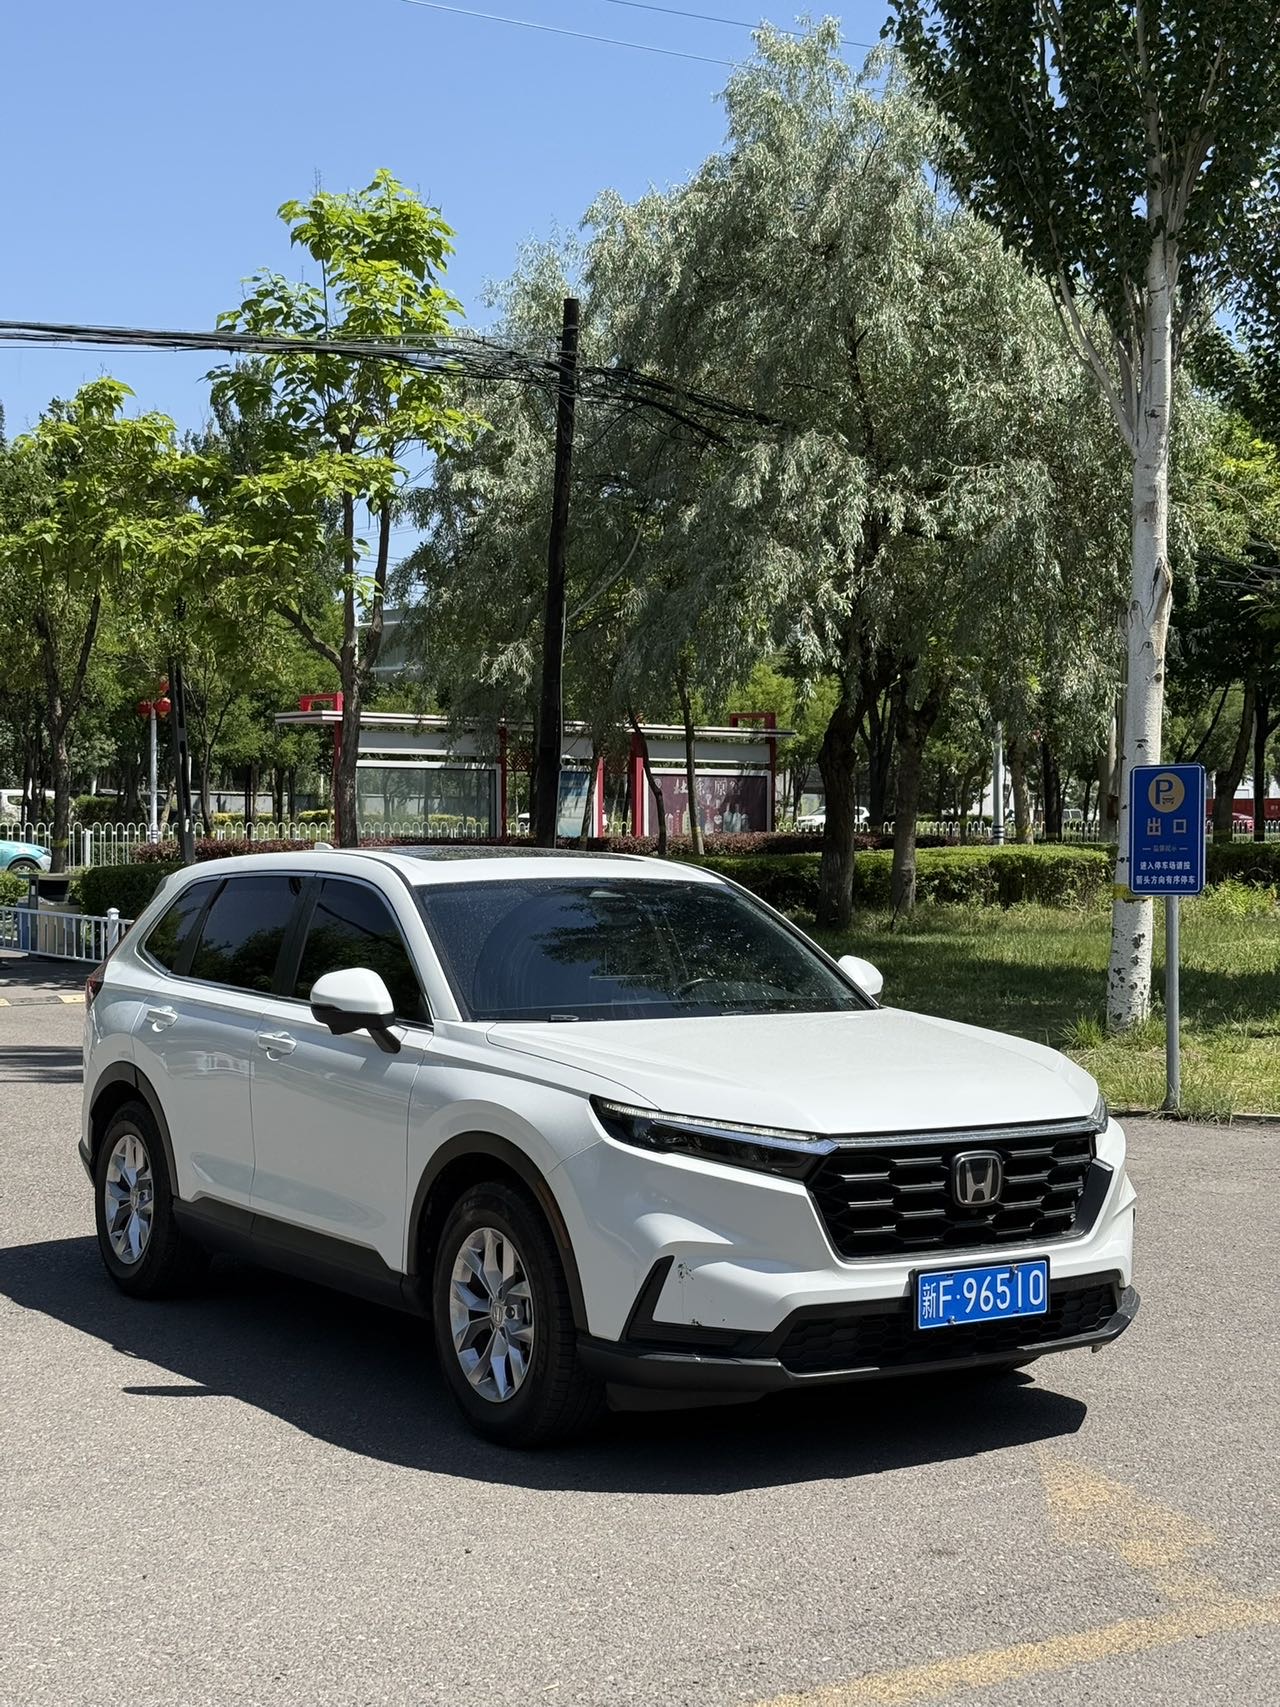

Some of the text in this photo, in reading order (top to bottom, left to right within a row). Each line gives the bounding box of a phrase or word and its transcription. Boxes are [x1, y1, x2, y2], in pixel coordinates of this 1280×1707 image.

[1155, 779, 1174, 805] P
[1146, 817, 1187, 836] 出口
[1139, 861, 1191, 870] 进入停车场请按
